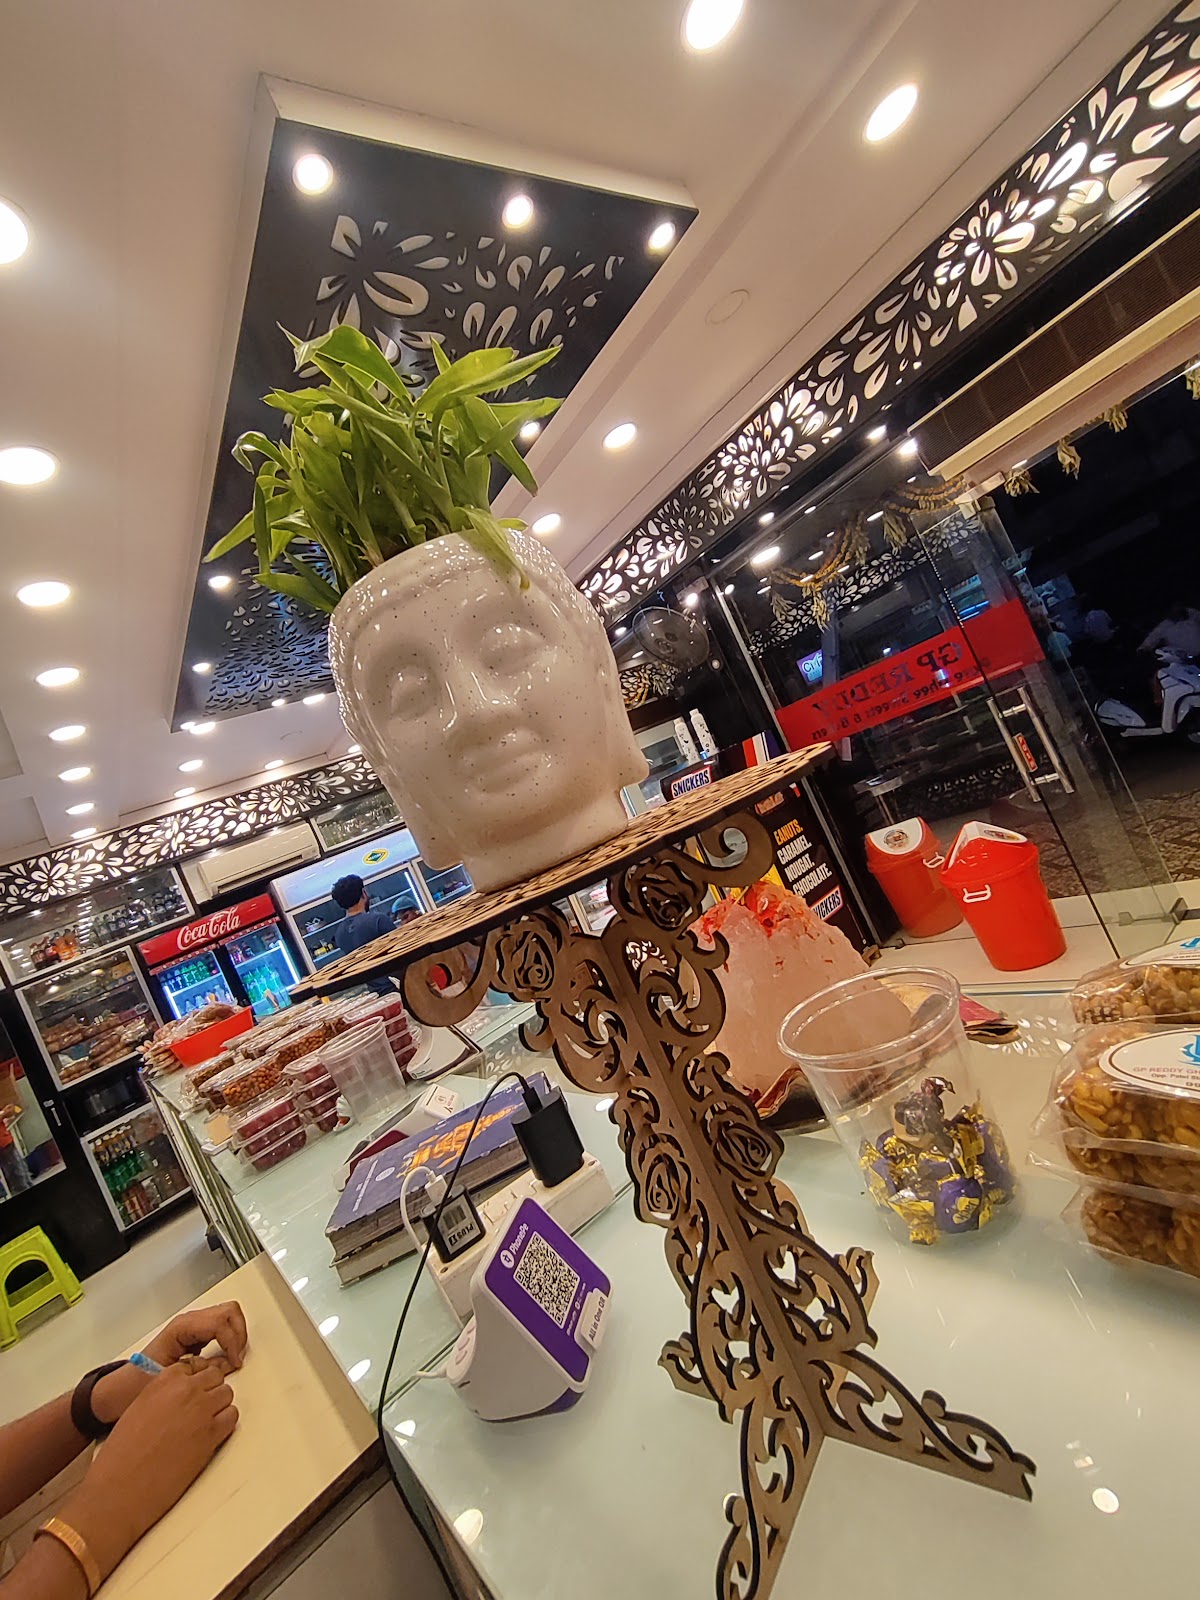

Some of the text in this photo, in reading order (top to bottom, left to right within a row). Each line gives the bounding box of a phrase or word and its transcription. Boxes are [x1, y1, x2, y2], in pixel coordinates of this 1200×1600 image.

[672, 769, 710, 797] SNICKERS
[773, 818, 804, 846] EANUTS.
[812, 889, 841, 919] ICKERS
[177, 906, 241, 951] Coca-Cola
[509, 1222, 529, 1255] PhonePe
[593, 1307, 602, 1321] One
[597, 1296, 606, 1309] QR
[588, 1328, 597, 1341] All
